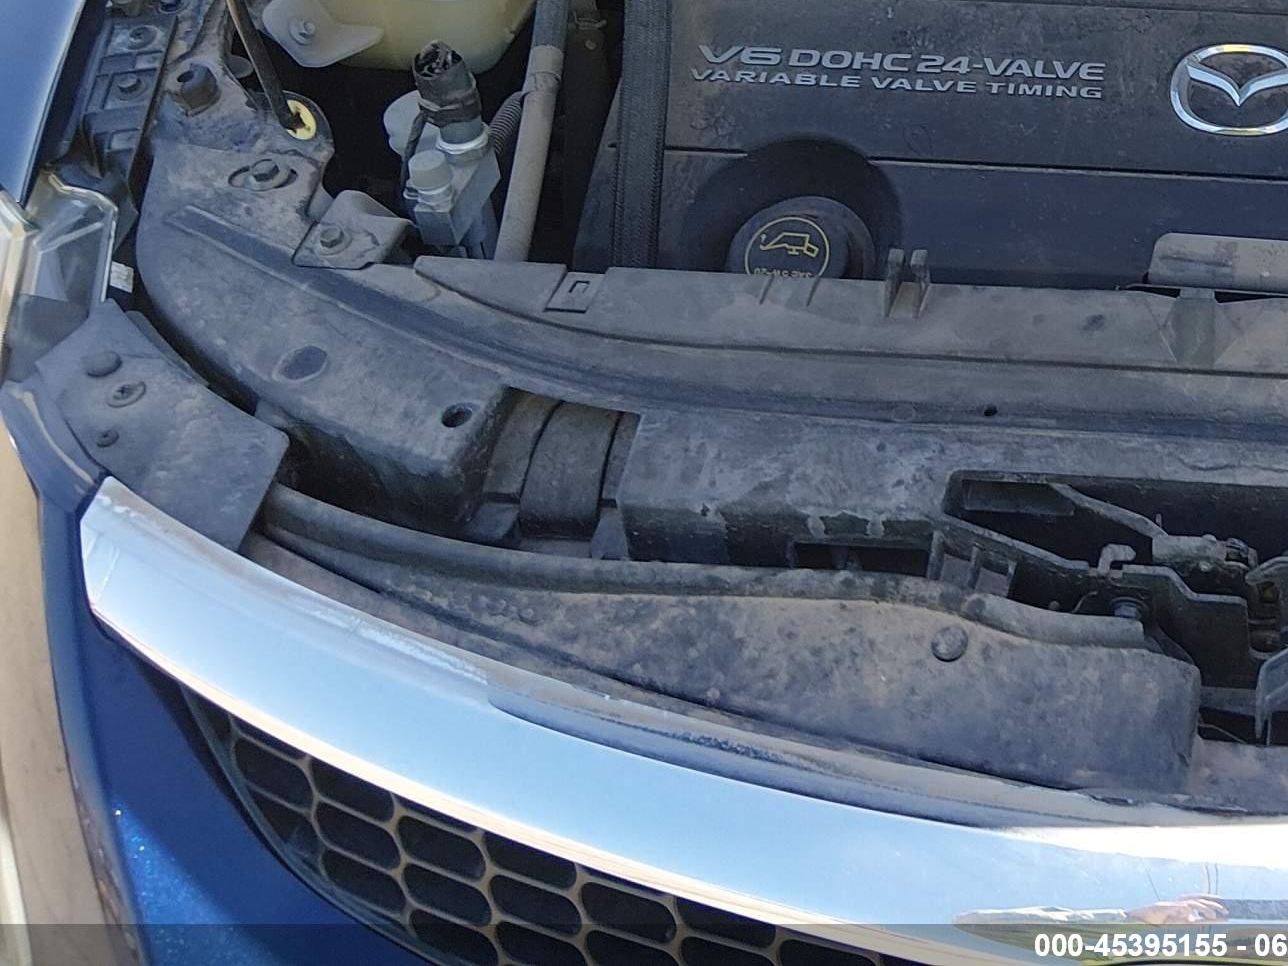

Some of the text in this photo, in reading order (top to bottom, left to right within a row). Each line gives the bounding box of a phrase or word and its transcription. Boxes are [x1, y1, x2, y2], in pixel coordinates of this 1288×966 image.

[699, 44, 1106, 81] V6 DOHC 24-VALVE
[691, 68, 1103, 99] VARIABLE VALVE TIMING
